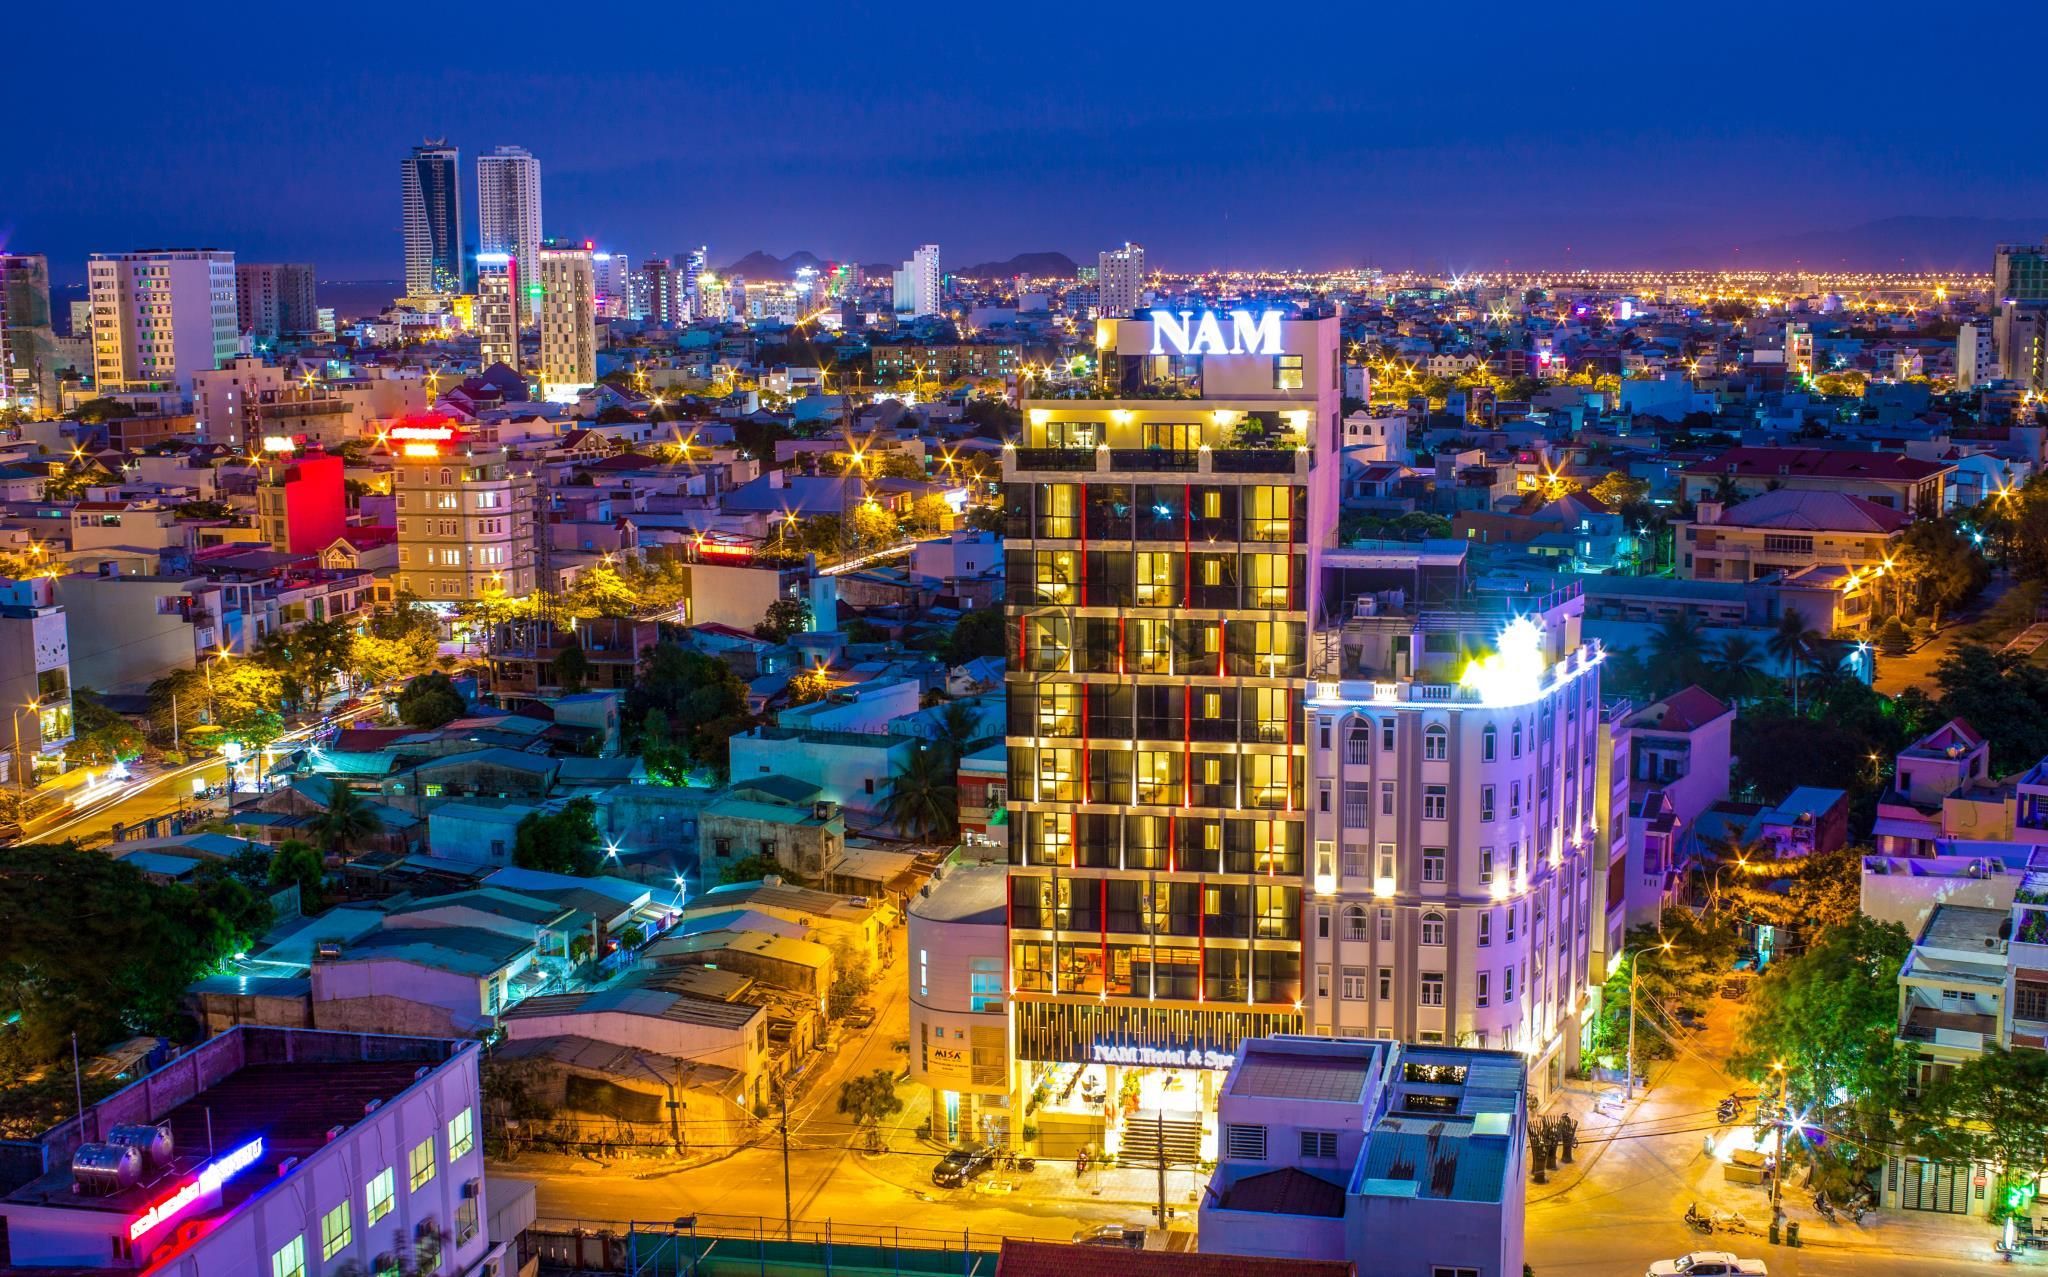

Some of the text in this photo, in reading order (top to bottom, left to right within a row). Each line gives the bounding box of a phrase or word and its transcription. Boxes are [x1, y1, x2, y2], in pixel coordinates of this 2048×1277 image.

[1150, 310, 1285, 355] NAM
[934, 1049, 960, 1059] MISA
[1094, 1045, 1137, 1062] NAM
[1139, 1047, 1185, 1065] Hotel
[1187, 1049, 1202, 1065] &
